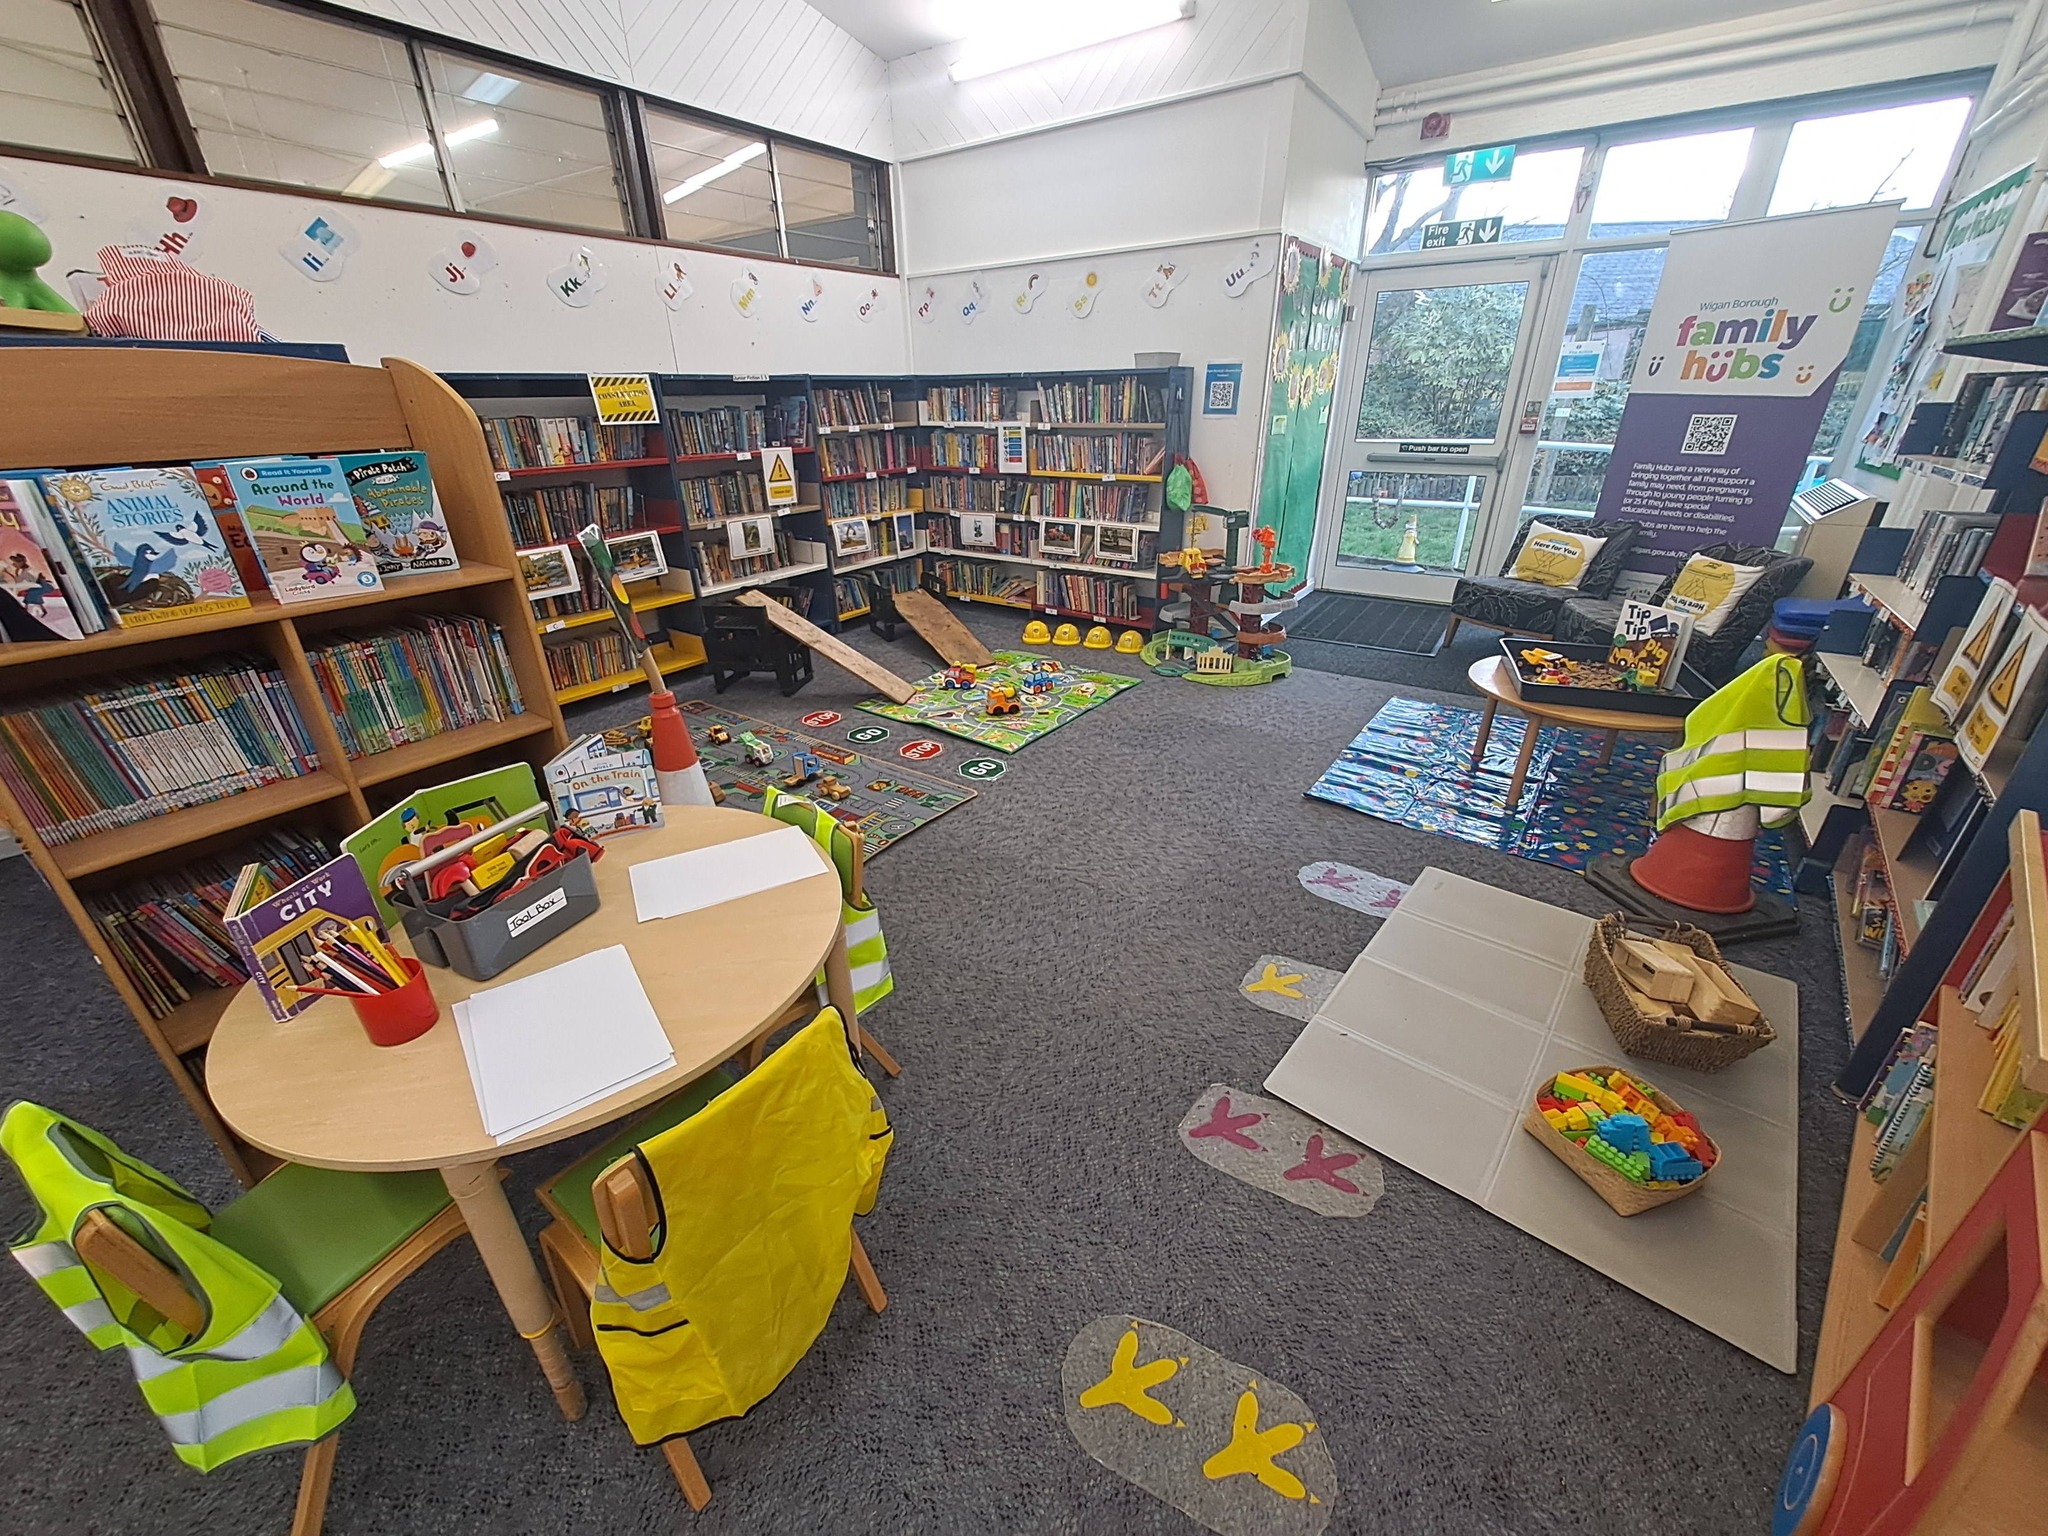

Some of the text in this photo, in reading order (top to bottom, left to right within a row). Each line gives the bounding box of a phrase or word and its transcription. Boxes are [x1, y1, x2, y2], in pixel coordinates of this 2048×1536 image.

[1428, 226, 1449, 236] Fire
[1426, 236, 1446, 248] exit
[445, 262, 465, 283] Jj
[1225, 269, 1245, 288] Uu
[560, 276, 583, 297] Kk
[802, 299, 815, 315] Nn
[859, 303, 871, 316] Oo
[917, 301, 930, 317] Pp
[962, 301, 977, 317] Qq
[1074, 294, 1088, 311] Ss
[1700, 297, 1779, 312] Wigan Borough
[1676, 308, 1819, 350] family
[353, 467, 381, 480] Pirate
[381, 462, 407, 472] Patch
[1633, 462, 1655, 472] Family
[1712, 468, 1730, 476] way
[131, 480, 167, 489] Blyton
[1631, 471, 1659, 480] bringing
[1660, 474, 1692, 482] together
[1717, 477, 1749, 485] support
[252, 479, 334, 495] Around the
[368, 480, 427, 498] Abominable
[1628, 480, 1649, 488] family
[1650, 482, 1665, 490] may
[1707, 487, 1750, 496] pregnancy
[107, 495, 178, 514] ANIMAL
[278, 492, 324, 506] World
[380, 496, 423, 507] Pirates
[1626, 489, 1652, 498] through
[1686, 494, 1714, 502] people
[1715, 496, 1743, 505] turning
[1648, 499, 1664, 508] they
[112, 508, 184, 528] STORIES
[1620, 506, 1660, 515] educational
[1656, 522, 1668, 530] are
[1669, 523, 1686, 531] here
[1696, 526, 1713, 534] help
[1714, 528, 1727, 536] the
[1534, 540, 1578, 556] Here for You
[413, 560, 437, 568] NATHAN
[285, 584, 316, 592] Ladybird
[1628, 604, 1651, 625] Tip
[1687, 602, 1706, 611] Here
[1624, 621, 1647, 640] Tip
[1645, 639, 1668, 666] Dig
[807, 712, 836, 727] STOP
[855, 728, 882, 741] GO
[906, 743, 936, 759] STOP
[969, 761, 997, 776] GO
[573, 769, 641, 791] On the Train
[272, 872, 331, 908] Wheels at Work
[280, 880, 332, 922] CITY
[536, 897, 555, 915] Box
